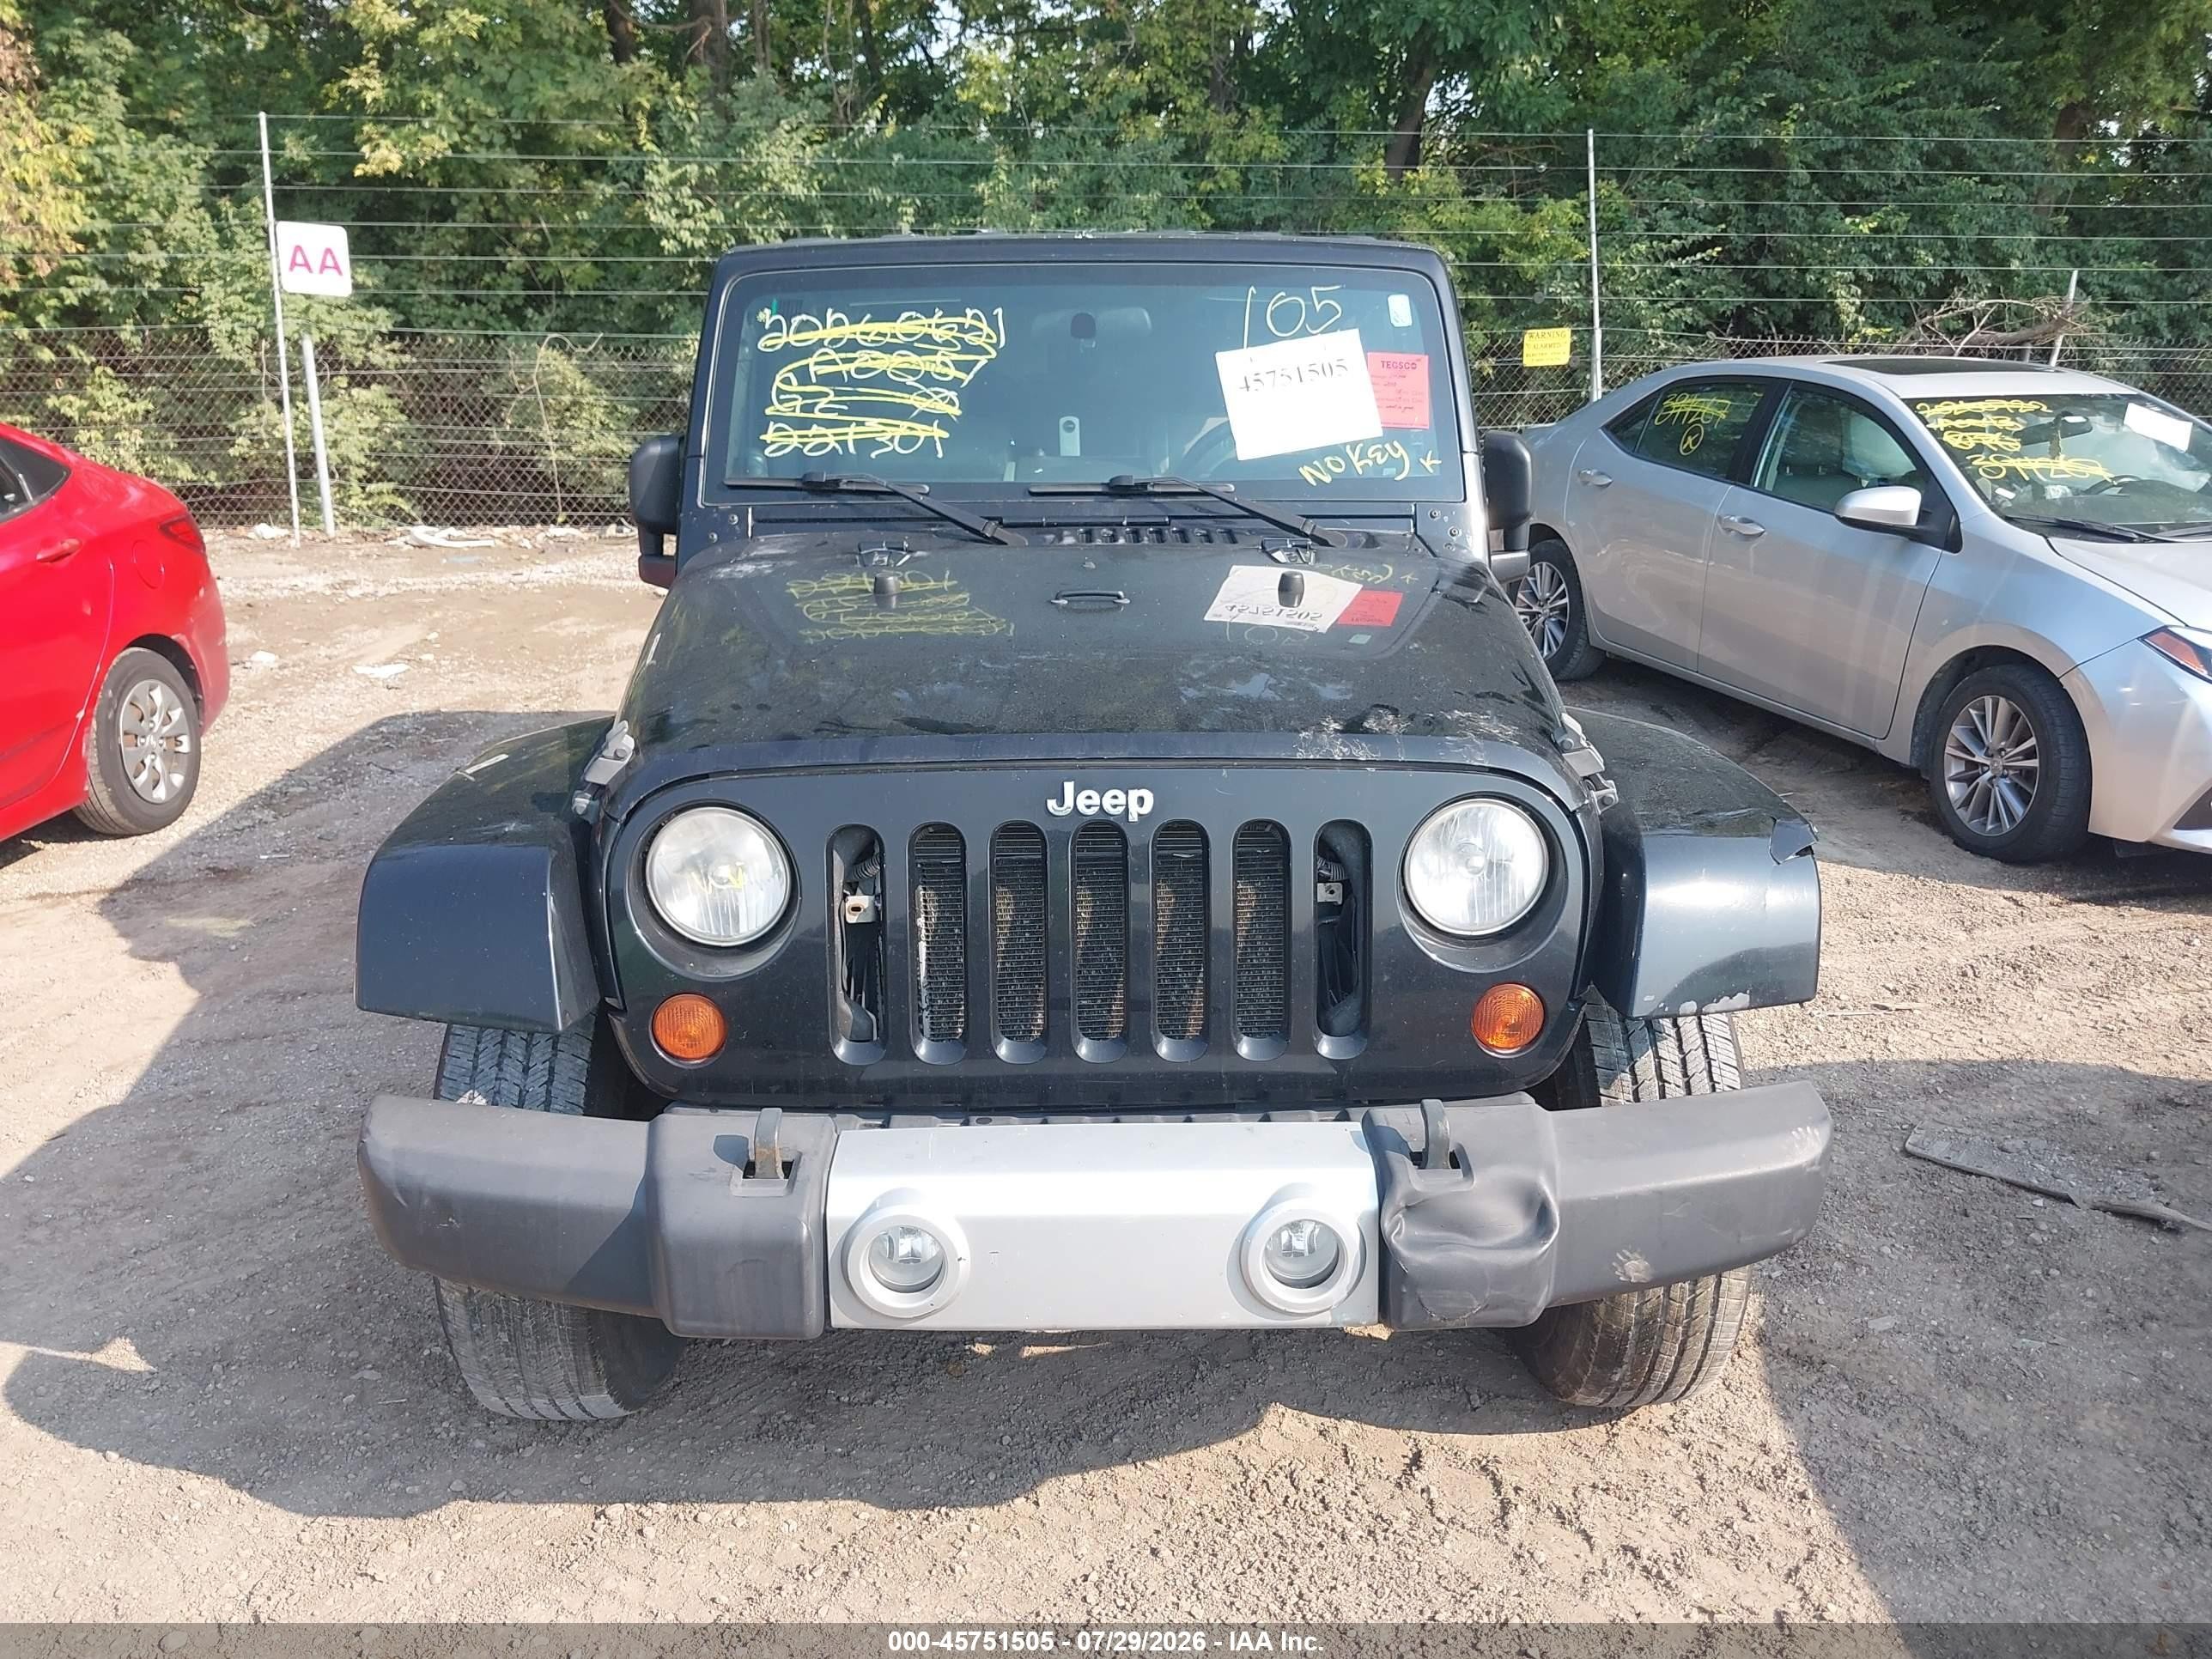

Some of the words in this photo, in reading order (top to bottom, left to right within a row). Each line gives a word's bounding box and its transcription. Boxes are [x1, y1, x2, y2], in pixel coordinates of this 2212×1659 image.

[289, 245, 343, 276] AA
[1243, 284, 1346, 349] 105
[1047, 781, 1154, 822] Jeep
